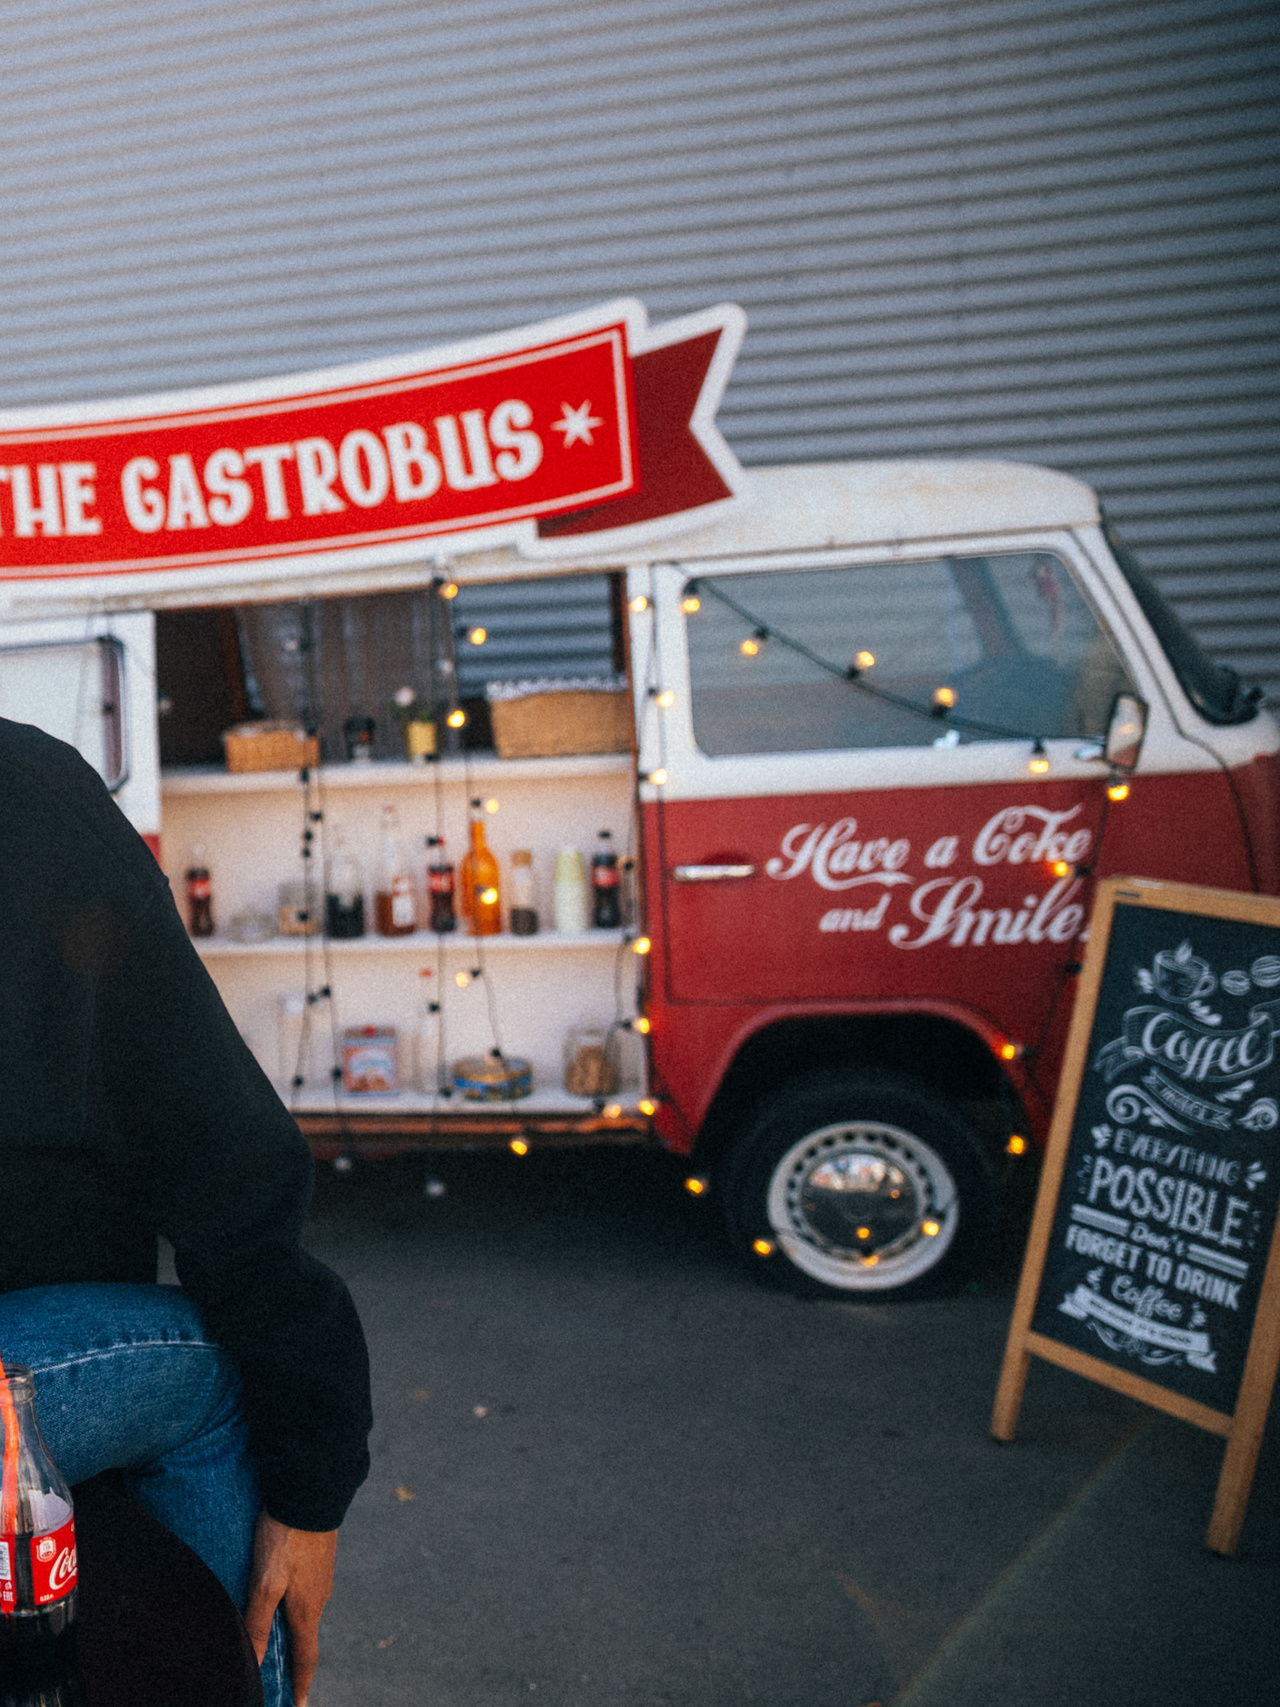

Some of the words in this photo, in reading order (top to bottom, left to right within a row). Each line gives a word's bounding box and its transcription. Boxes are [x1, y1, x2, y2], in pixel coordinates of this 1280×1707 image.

[120, 398, 545, 535] GASTROBUS
[765, 816, 914, 891] Have
[923, 835, 960, 869] a
[972, 804, 1092, 866] Coke
[819, 892, 892, 934] and
[1087, 1155, 1249, 1249] POSSIBLE
[1064, 1224, 1143, 1272] FORGET
[1146, 1252, 1173, 1284] TO
[1174, 1263, 1242, 1311] DRINK
[1111, 1275, 1184, 1321] Coffee
